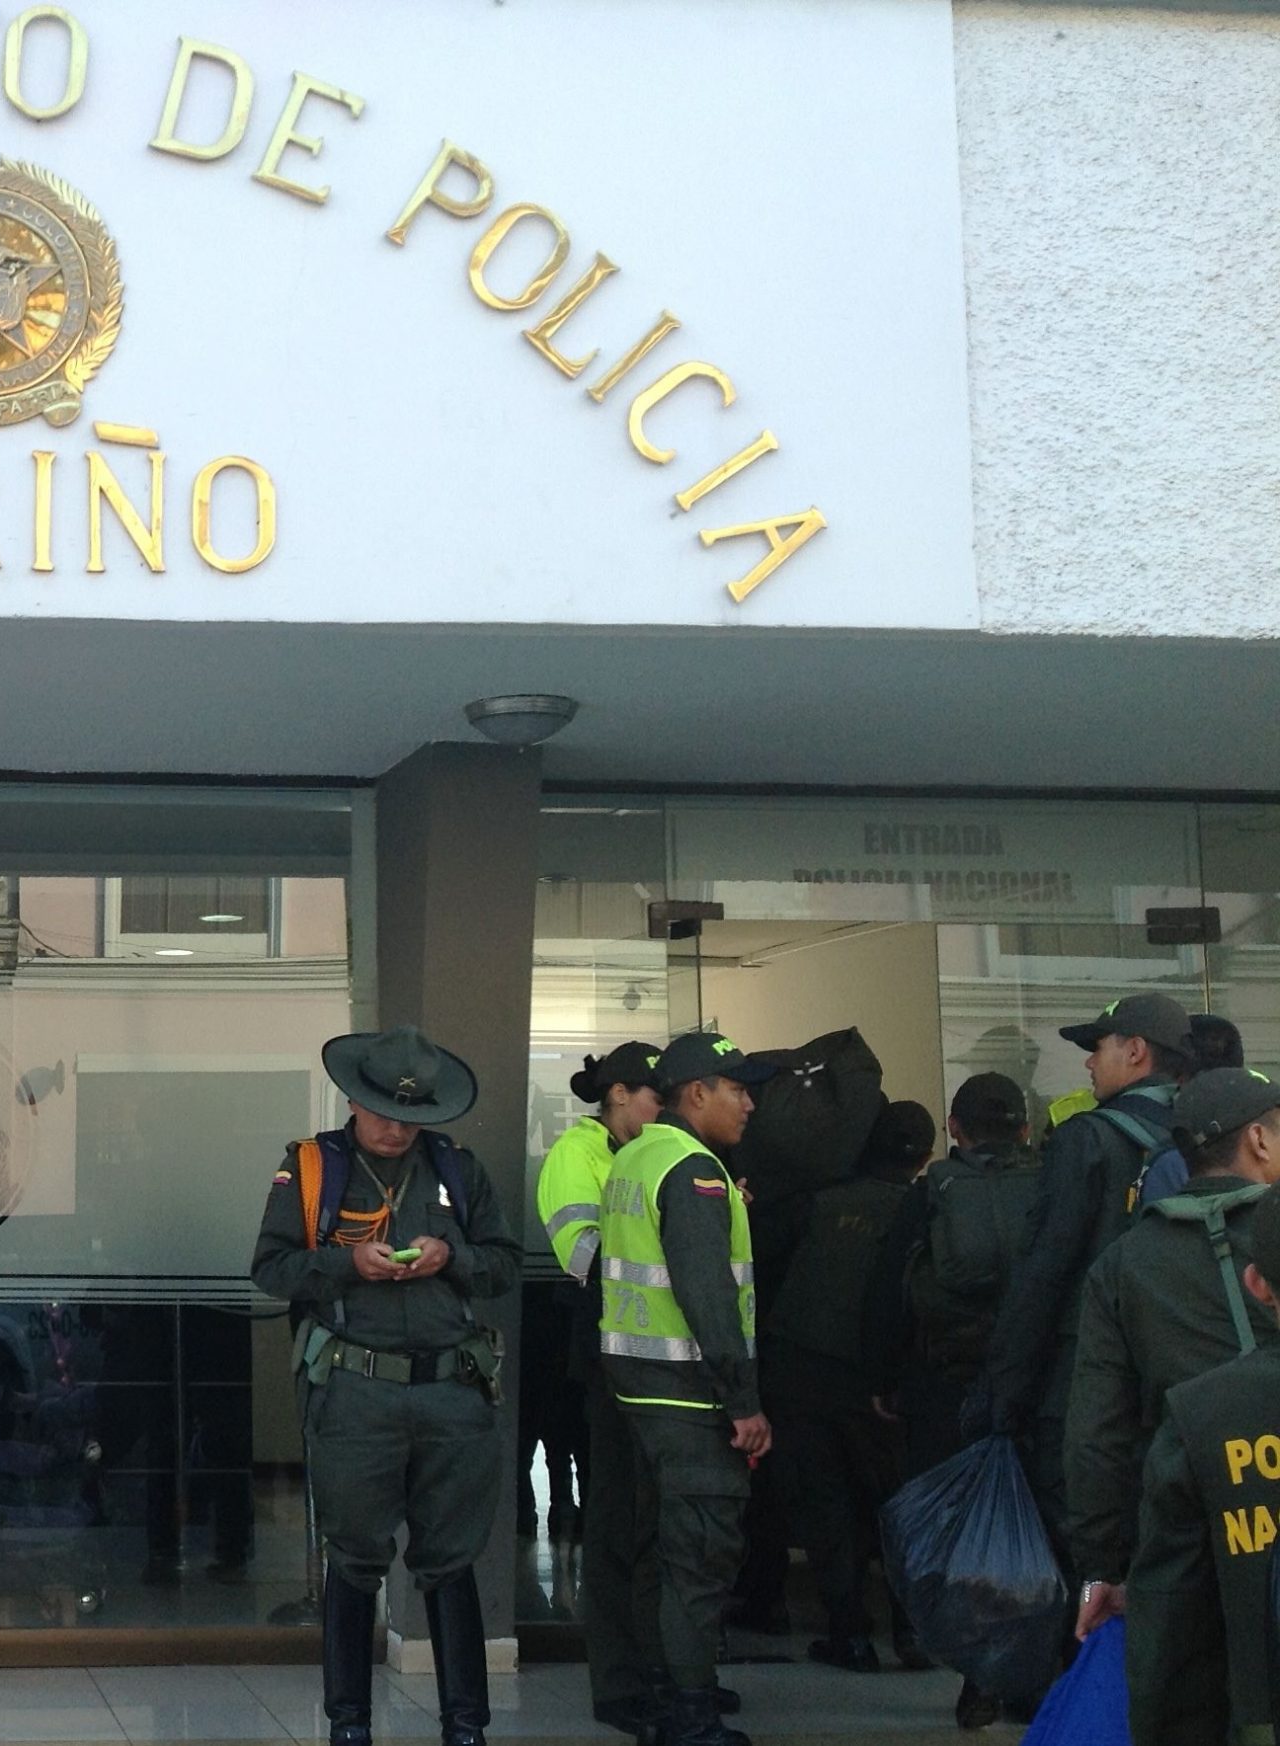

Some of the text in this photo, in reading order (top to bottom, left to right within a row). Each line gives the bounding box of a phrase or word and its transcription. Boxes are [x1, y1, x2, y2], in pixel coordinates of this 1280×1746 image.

[148, 34, 367, 206] DE
[385, 137, 827, 603] POLICIA
[864, 823, 1006, 856] ENTRADA
